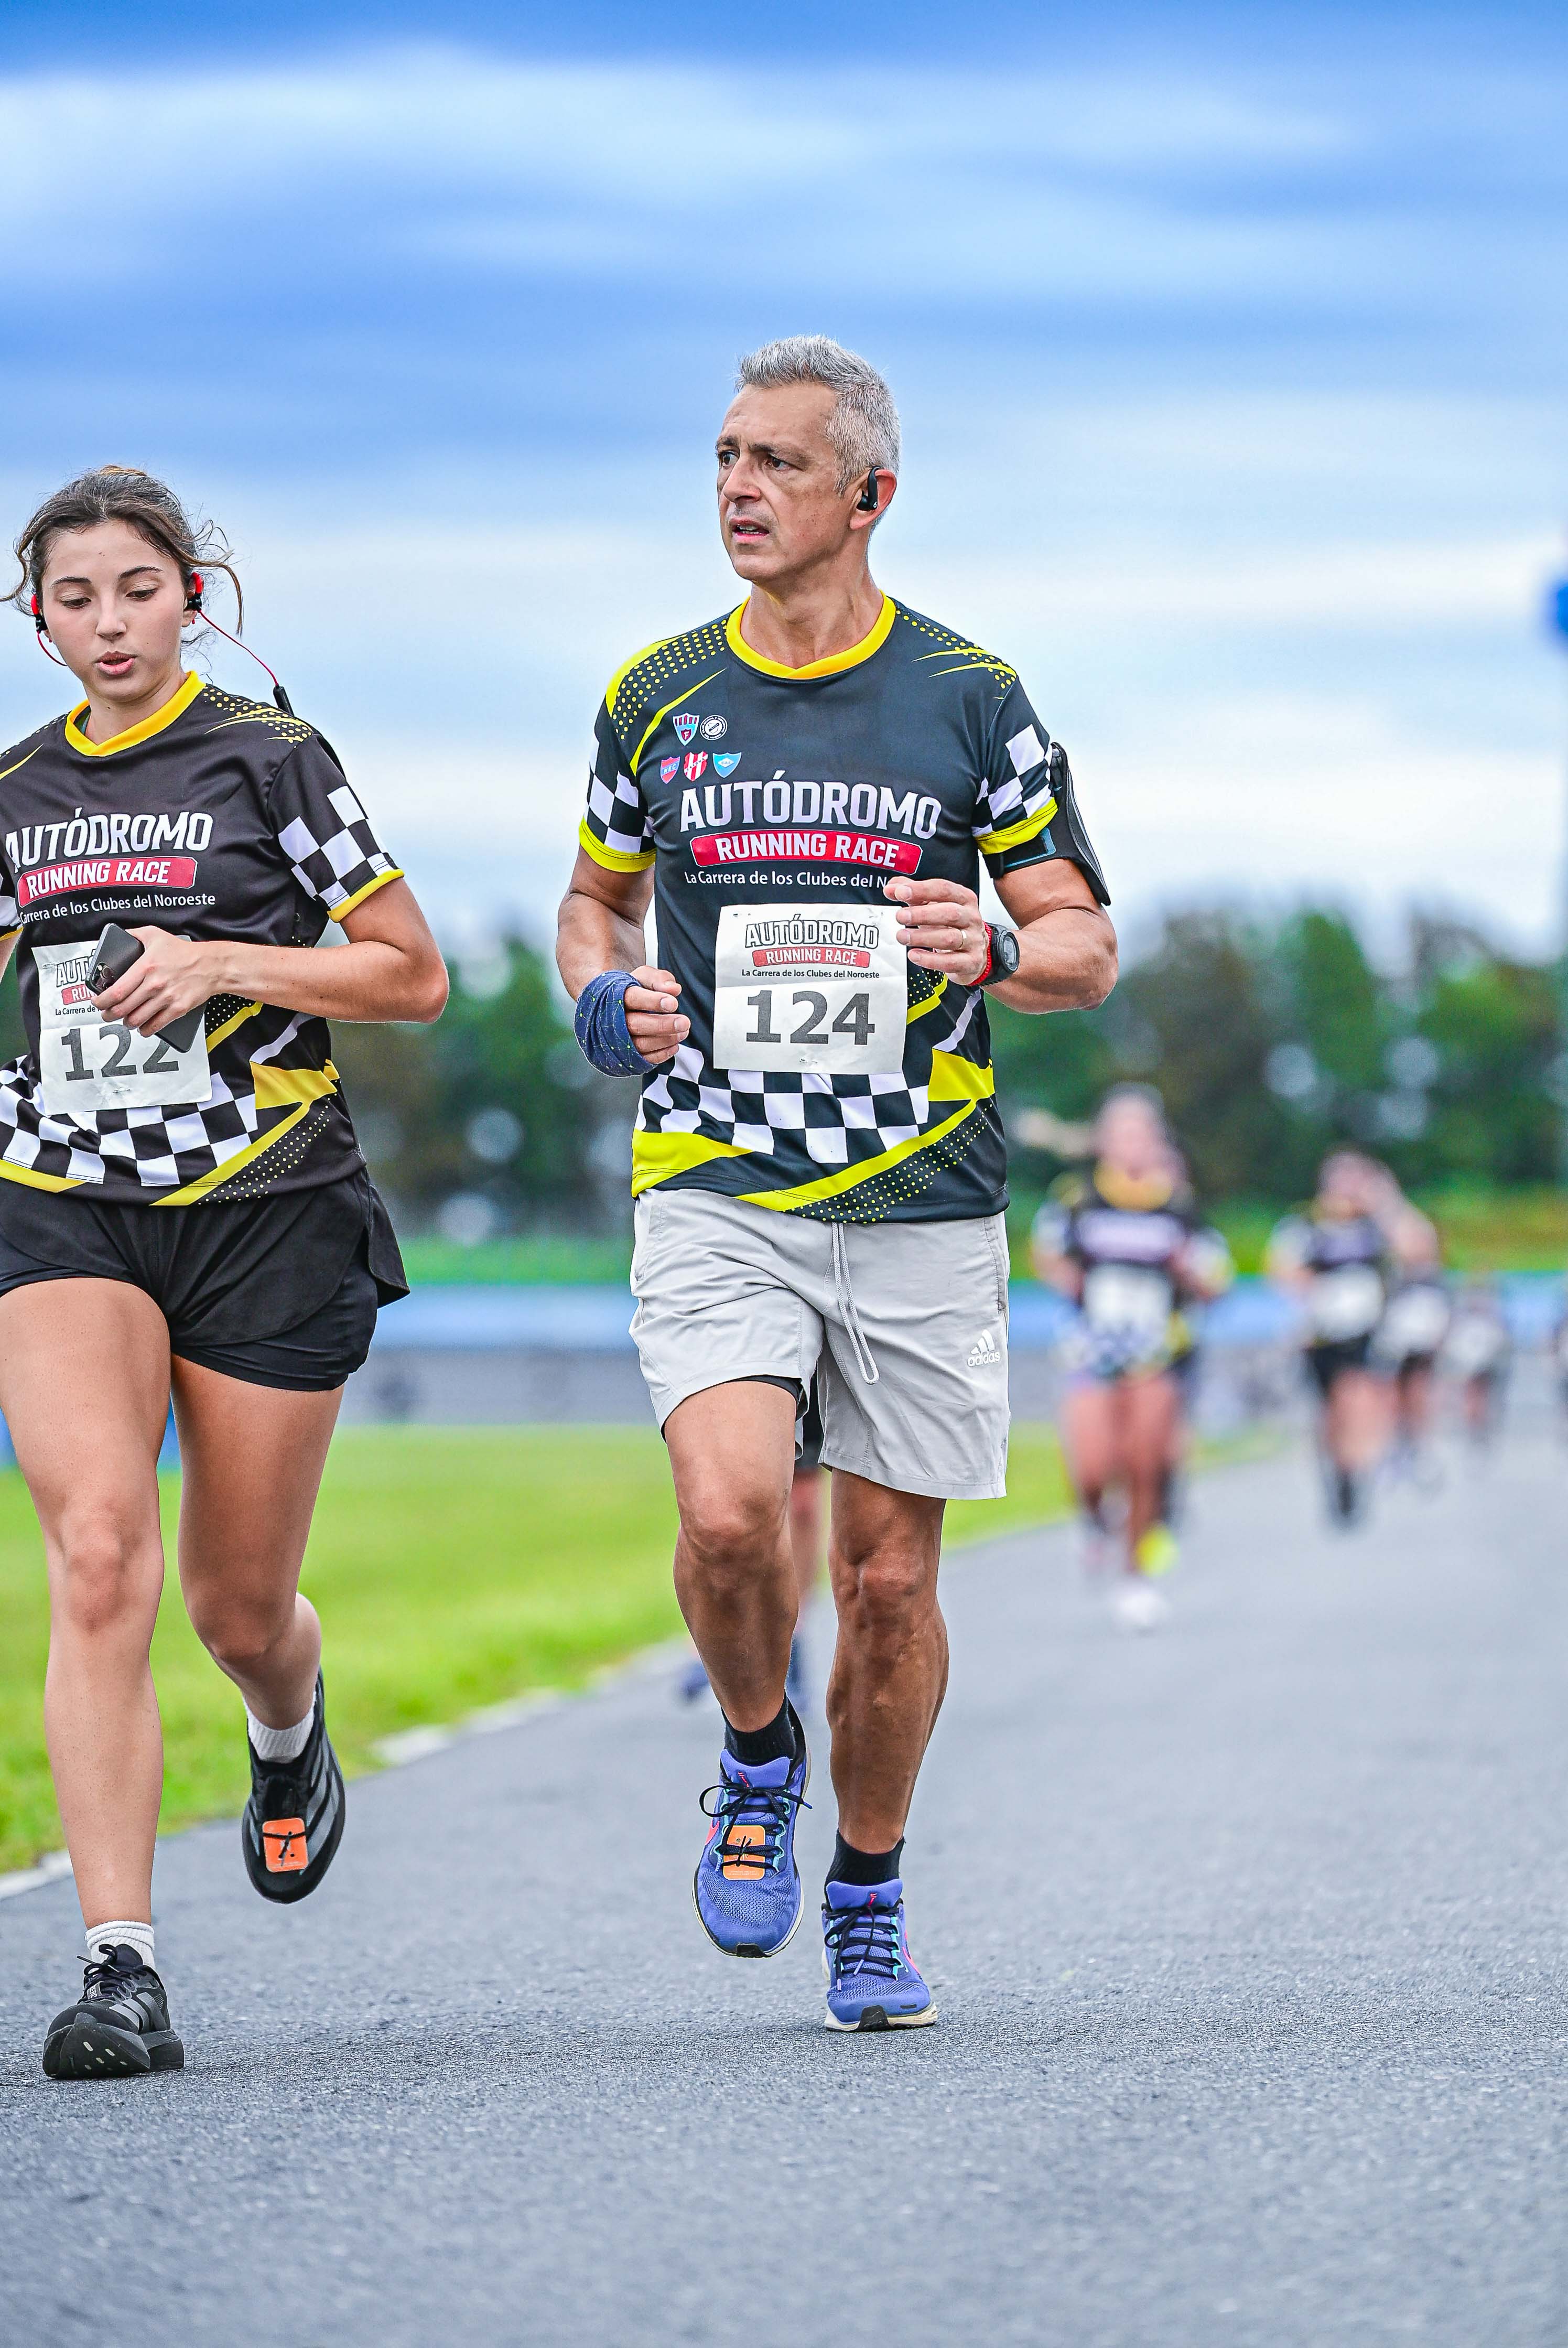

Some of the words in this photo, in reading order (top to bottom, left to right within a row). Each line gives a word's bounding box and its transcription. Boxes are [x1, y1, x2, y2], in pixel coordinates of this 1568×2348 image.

[680, 770, 942, 839] AUTÓDROMO
[5, 807, 213, 873] AUTÓDROMO
[716, 833, 827, 860] RUNNING
[835, 835, 900, 868] RACE
[26, 861, 110, 899] RUNNING
[116, 861, 171, 884] RACE
[684, 871, 697, 884] La
[698, 871, 745, 884] Carrera
[749, 871, 767, 884] de
[772, 871, 793, 885] los
[797, 871, 846, 886] Clubes
[850, 874, 872, 887] del
[19, 907, 50, 924] Carrera
[52, 904, 68, 918] de
[70, 900, 89, 915] los
[91, 897, 130, 912] Clubes
[133, 895, 152, 909] del
[155, 893, 215, 907] Noroeste
[745, 914, 879, 949] AUTÓDROMO
[765, 948, 821, 964] RUNNING
[825, 949, 857, 965] RACE
[62, 1007, 85, 1015] Carrera
[746, 989, 875, 1046] 124
[967, 1351, 1000, 1367] adidas
